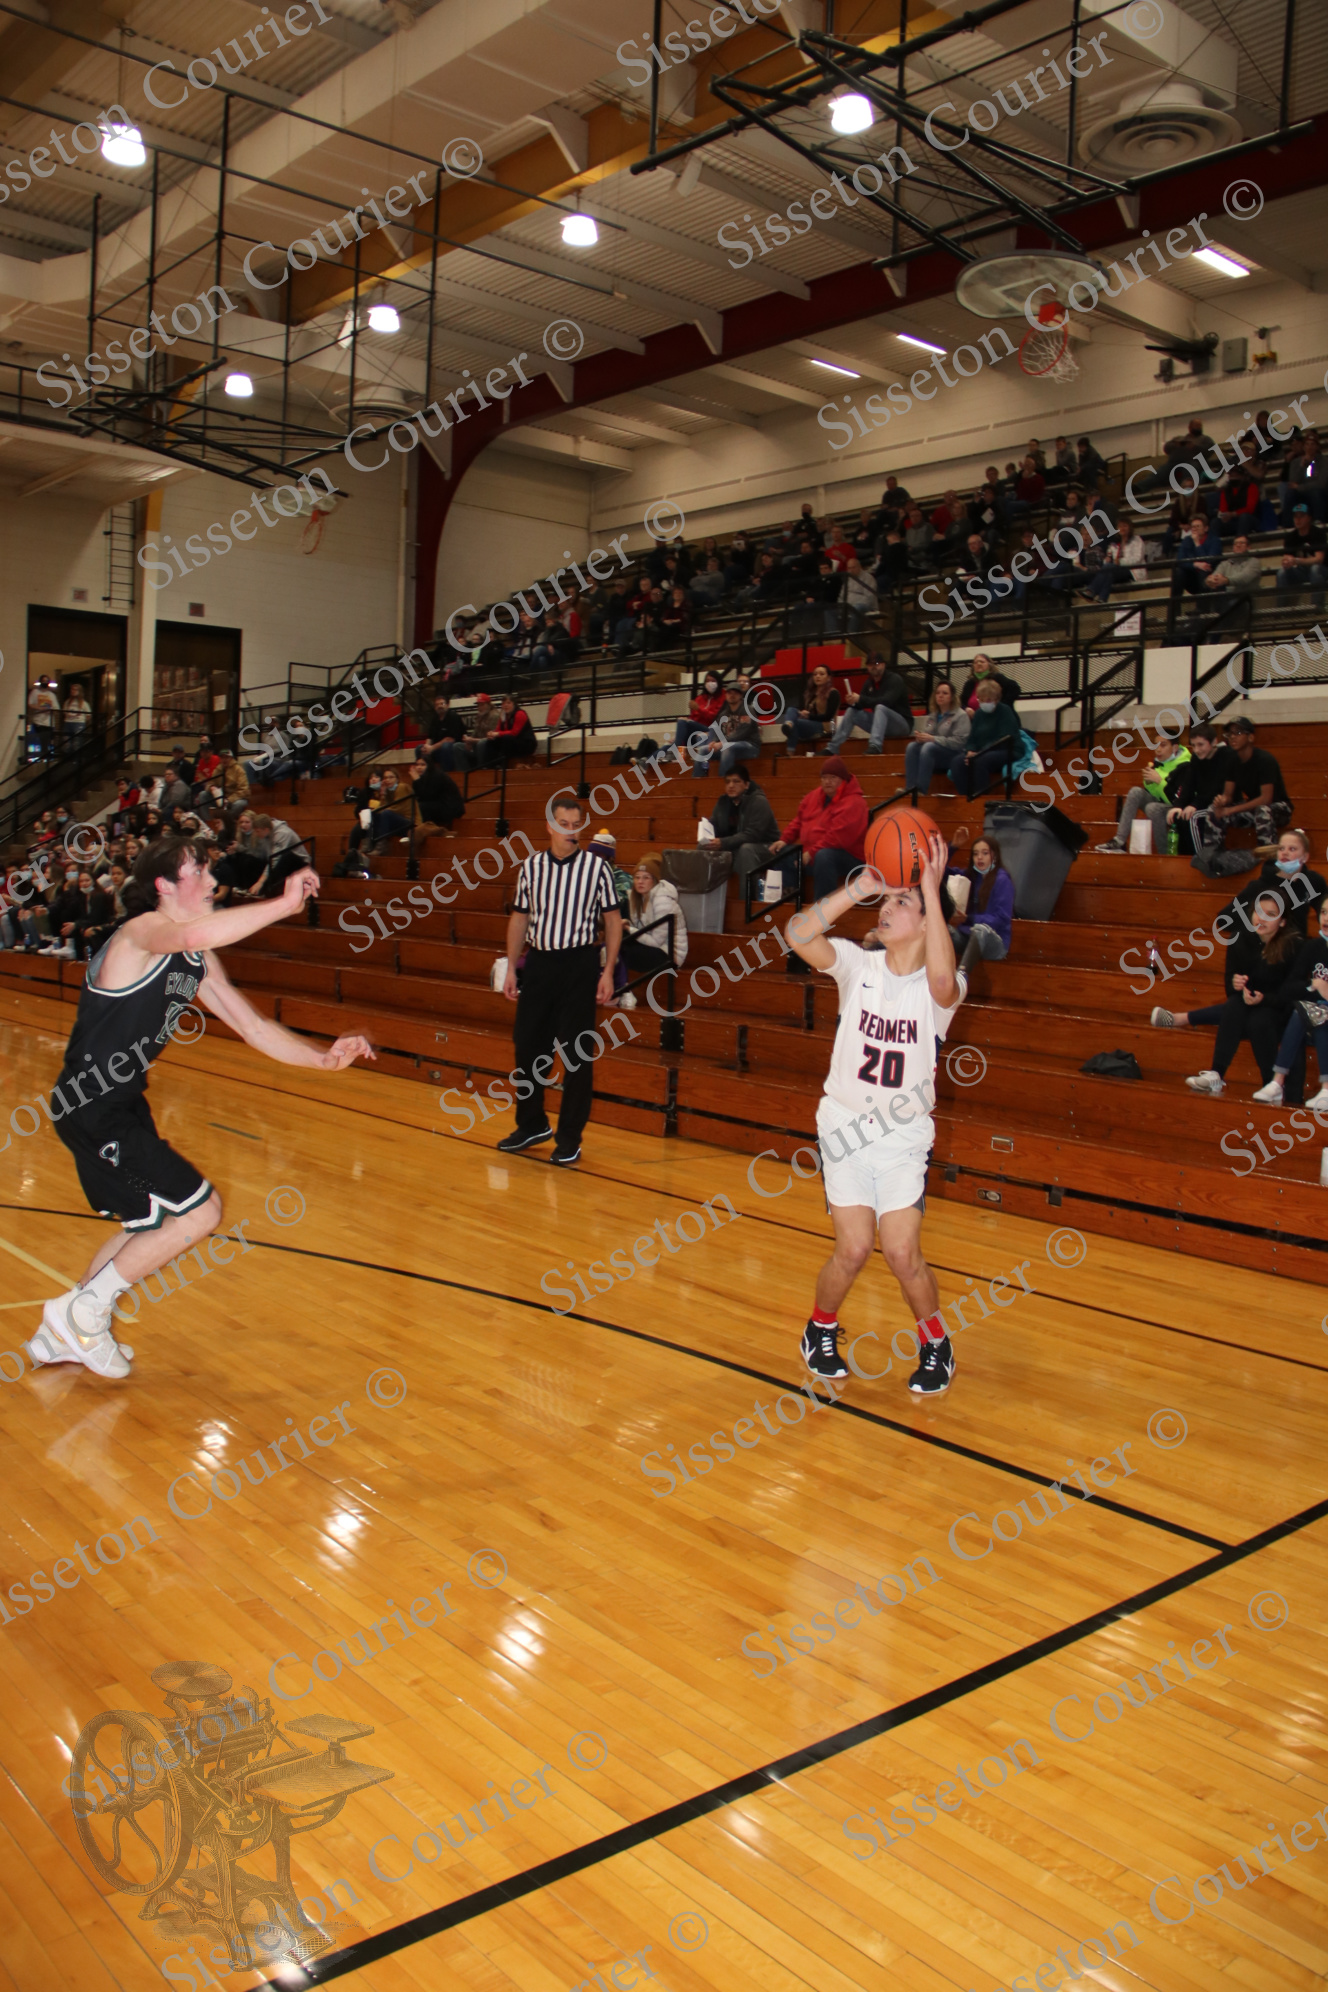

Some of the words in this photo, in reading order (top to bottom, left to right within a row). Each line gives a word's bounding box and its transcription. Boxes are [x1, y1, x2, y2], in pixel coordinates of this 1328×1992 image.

[908, 832, 920, 869] ELITE
[858, 1008, 918, 1044] REDMEN
[857, 1043, 905, 1089] 20
